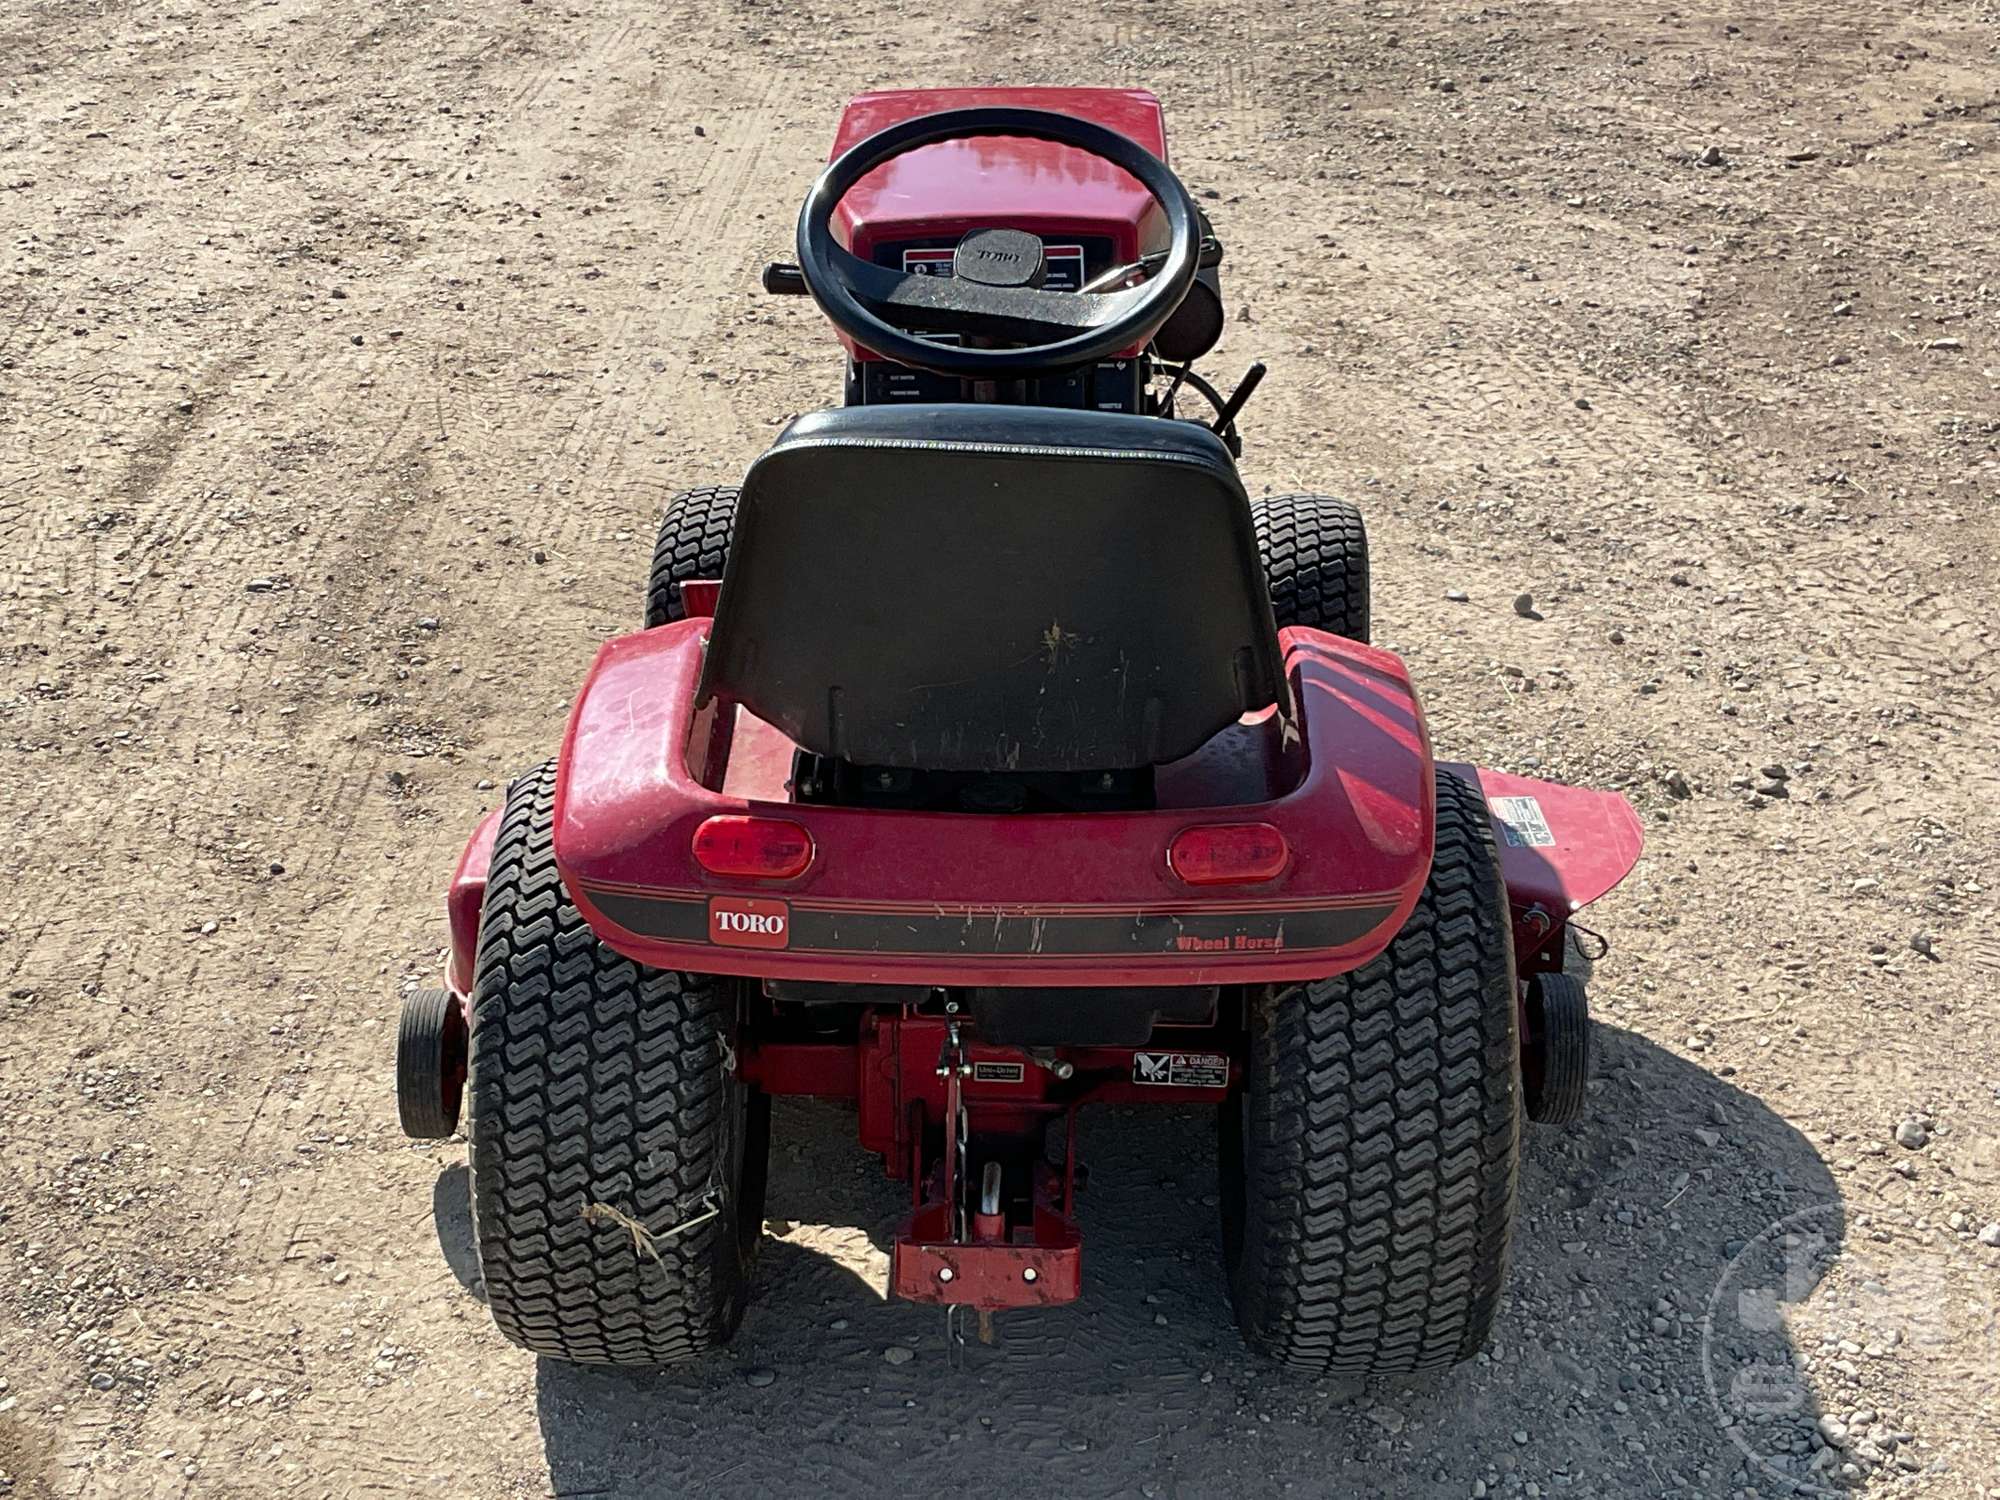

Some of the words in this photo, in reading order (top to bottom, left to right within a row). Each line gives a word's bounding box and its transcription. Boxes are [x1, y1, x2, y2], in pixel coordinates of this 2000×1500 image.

[715, 911, 784, 934] TORO
[1176, 936, 1230, 950] Wheel
[1234, 935, 1284, 949] Horse
[1189, 1056, 1225, 1066] DANGER
